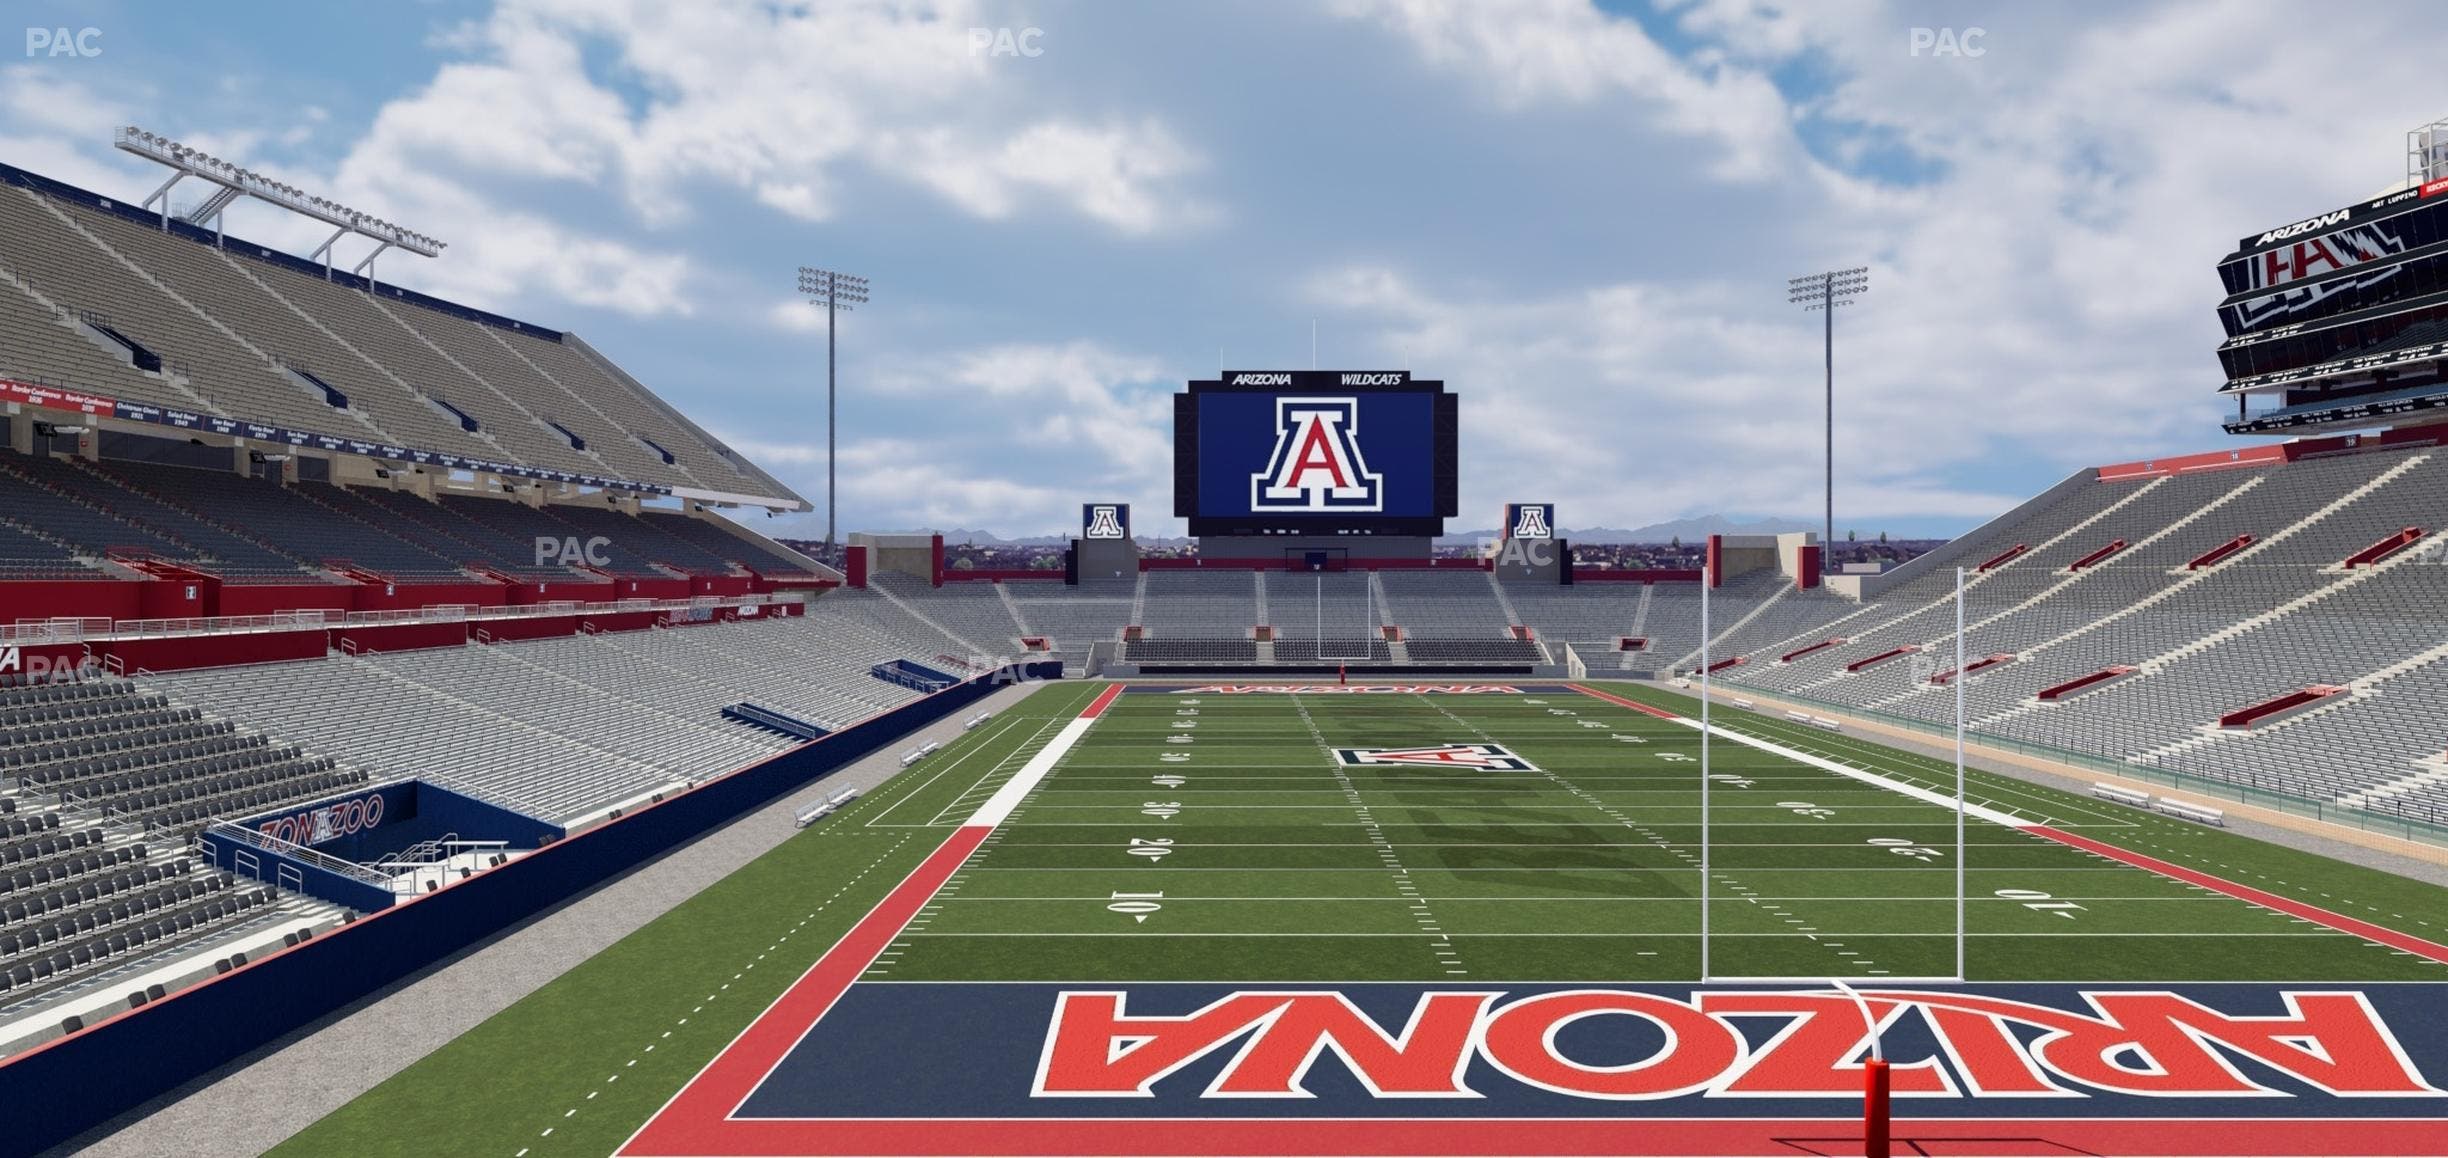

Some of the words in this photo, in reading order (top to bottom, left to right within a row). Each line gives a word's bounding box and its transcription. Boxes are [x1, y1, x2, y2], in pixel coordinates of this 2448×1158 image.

[2255, 209, 2350, 247] ARIZONA
[1232, 374, 1292, 385] ARIZONA
[1341, 374, 1402, 385] WILDCATS
[1141, 801, 1181, 816] 30
[1776, 801, 1836, 817] 30
[259, 794, 384, 853] ZONAZOO
[1127, 838, 1174, 856] 20
[1866, 838, 1943, 858] 20
[1106, 891, 1164, 913] 10
[1994, 889, 2088, 912] 10
[1030, 991, 2448, 1098] ARIZONA
